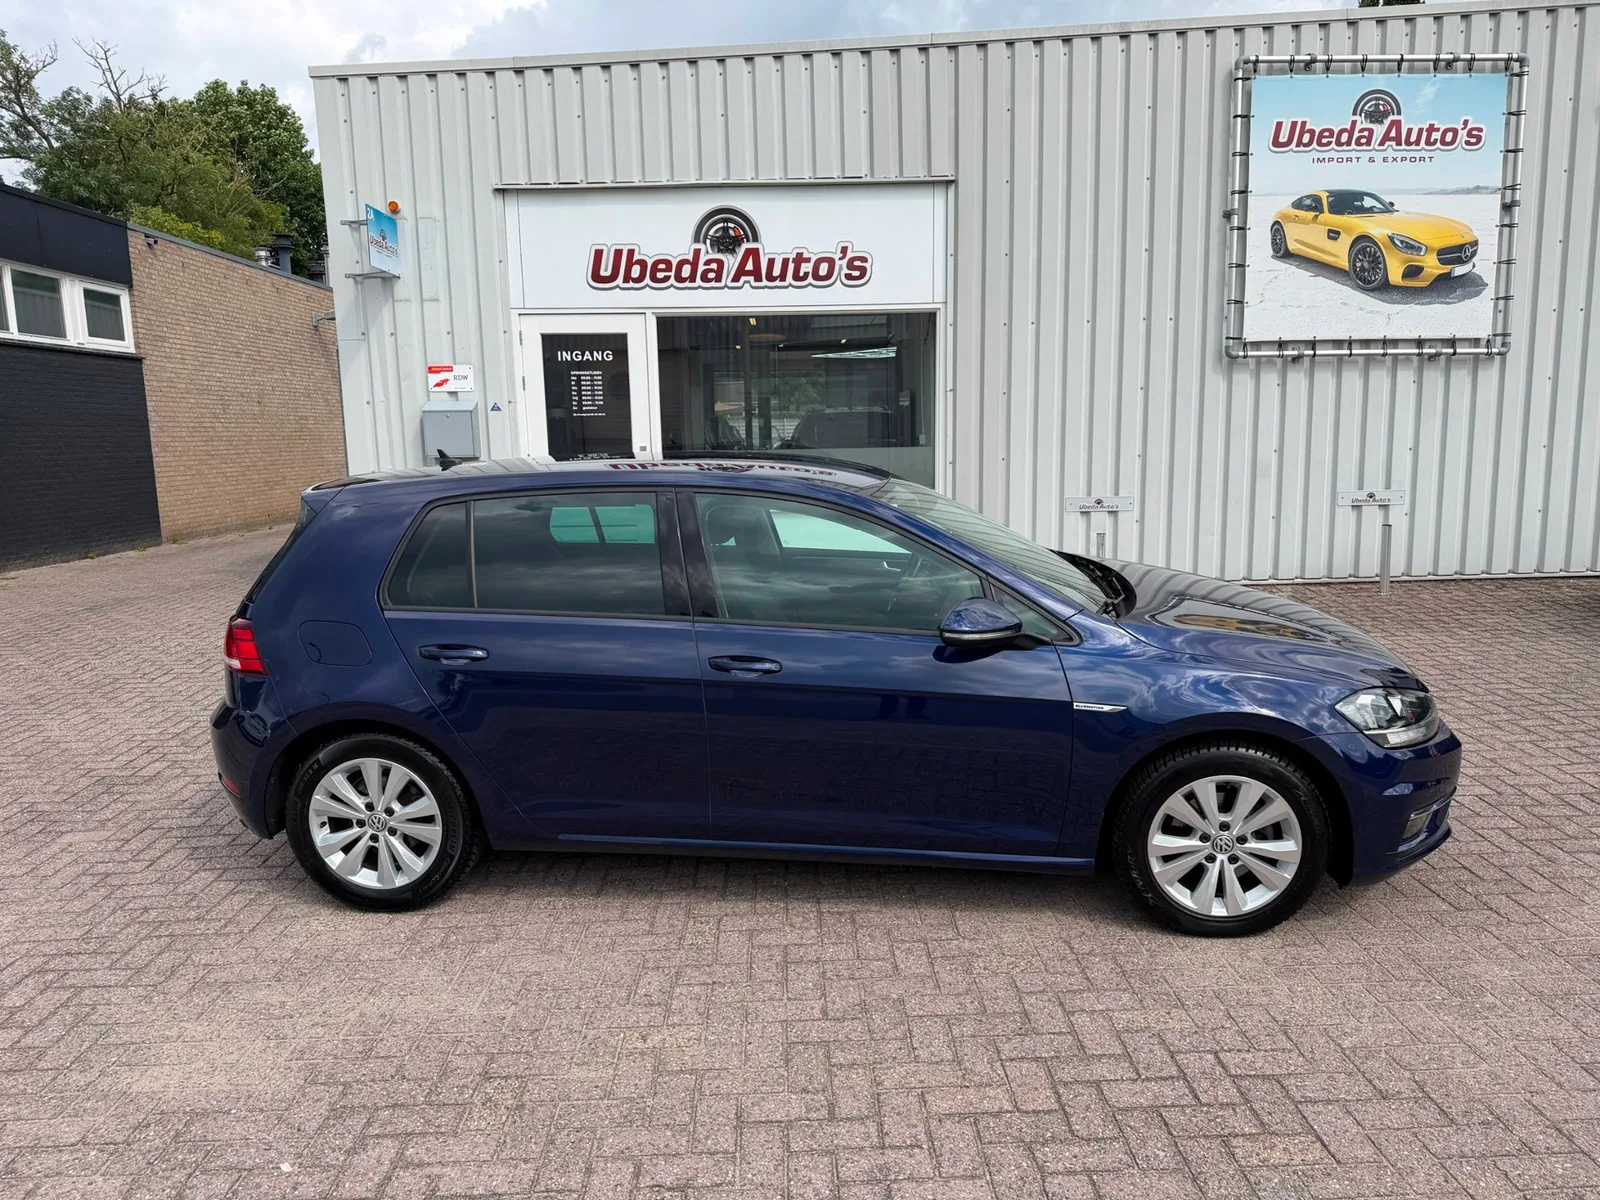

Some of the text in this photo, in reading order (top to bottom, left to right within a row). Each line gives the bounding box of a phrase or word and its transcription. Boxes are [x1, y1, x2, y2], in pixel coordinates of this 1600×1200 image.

[1271, 118, 1484, 148] Ubeda Auto's
[1312, 156, 1361, 164] IMPORT
[590, 245, 868, 284] Ubeda Auto's
[557, 350, 614, 361] INGANG
